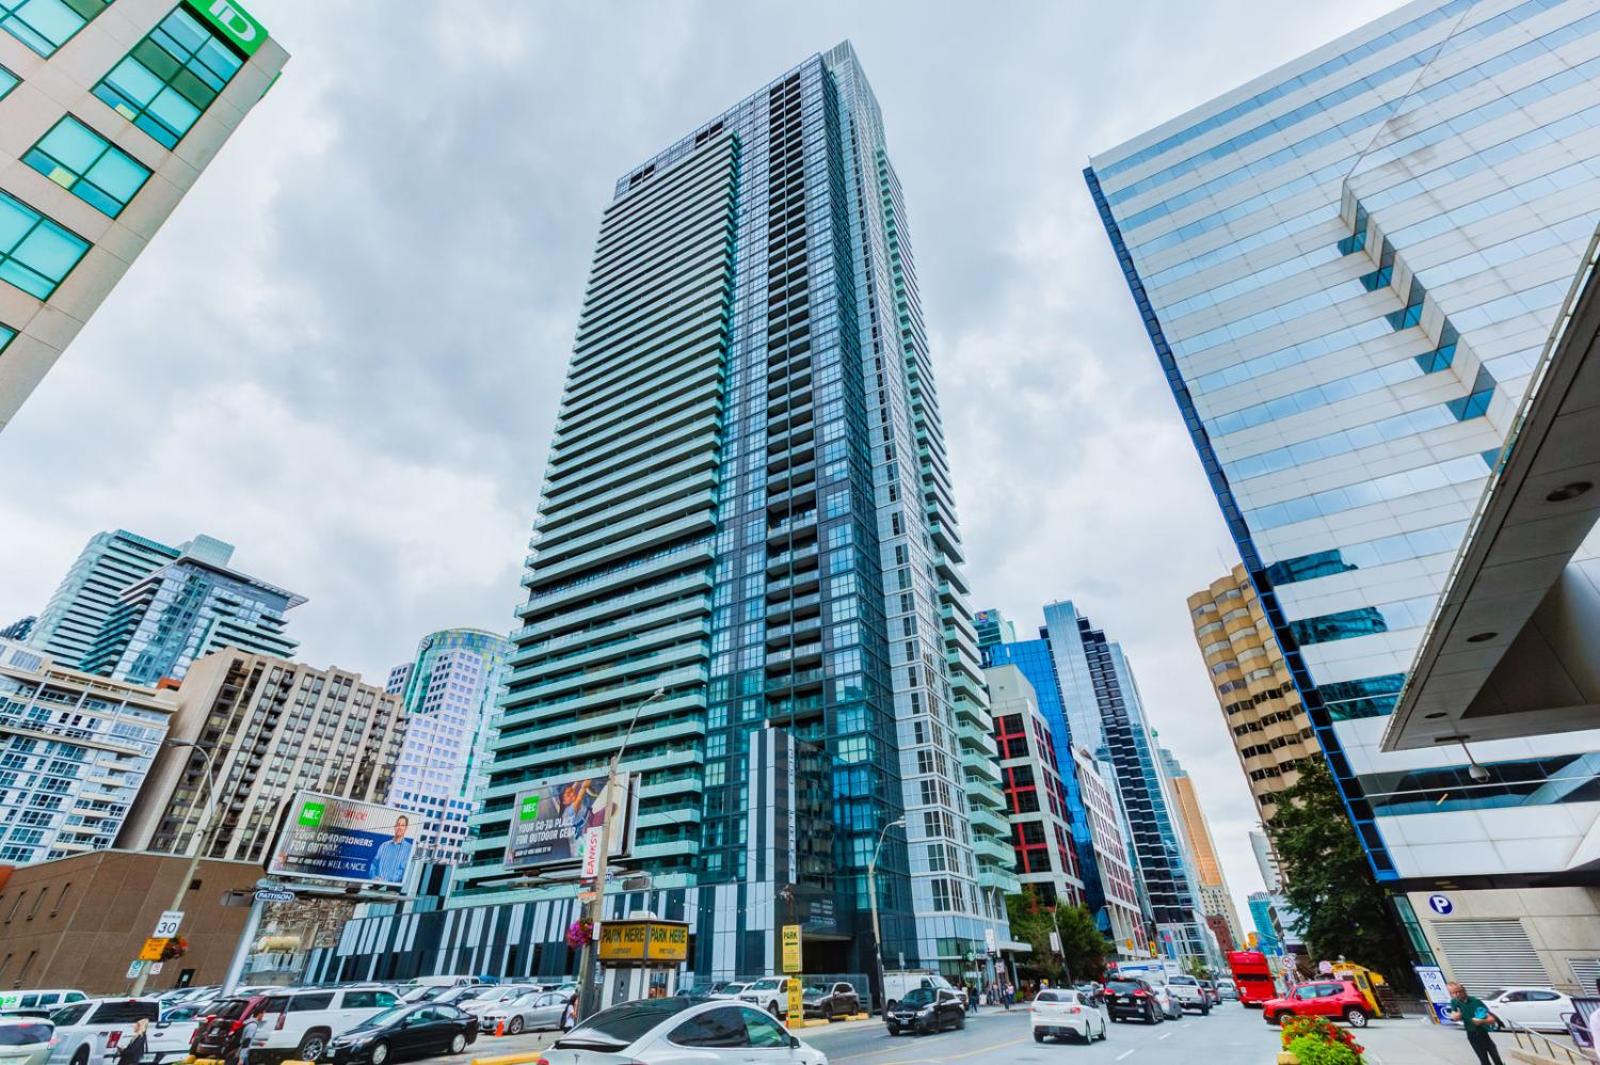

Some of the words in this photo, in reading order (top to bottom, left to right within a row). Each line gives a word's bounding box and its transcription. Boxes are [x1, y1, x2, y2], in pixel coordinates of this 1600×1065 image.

[523, 803, 536, 812] MEC
[529, 829, 559, 844] OUTDOOR
[258, 892, 292, 900] PATTISON
[157, 921, 177, 934] 30
[602, 927, 622, 944] PARK
[624, 927, 645, 944] HERE
[650, 927, 670, 944] PARK
[670, 927, 686, 945] HERE
[784, 931, 797, 940] PARK
